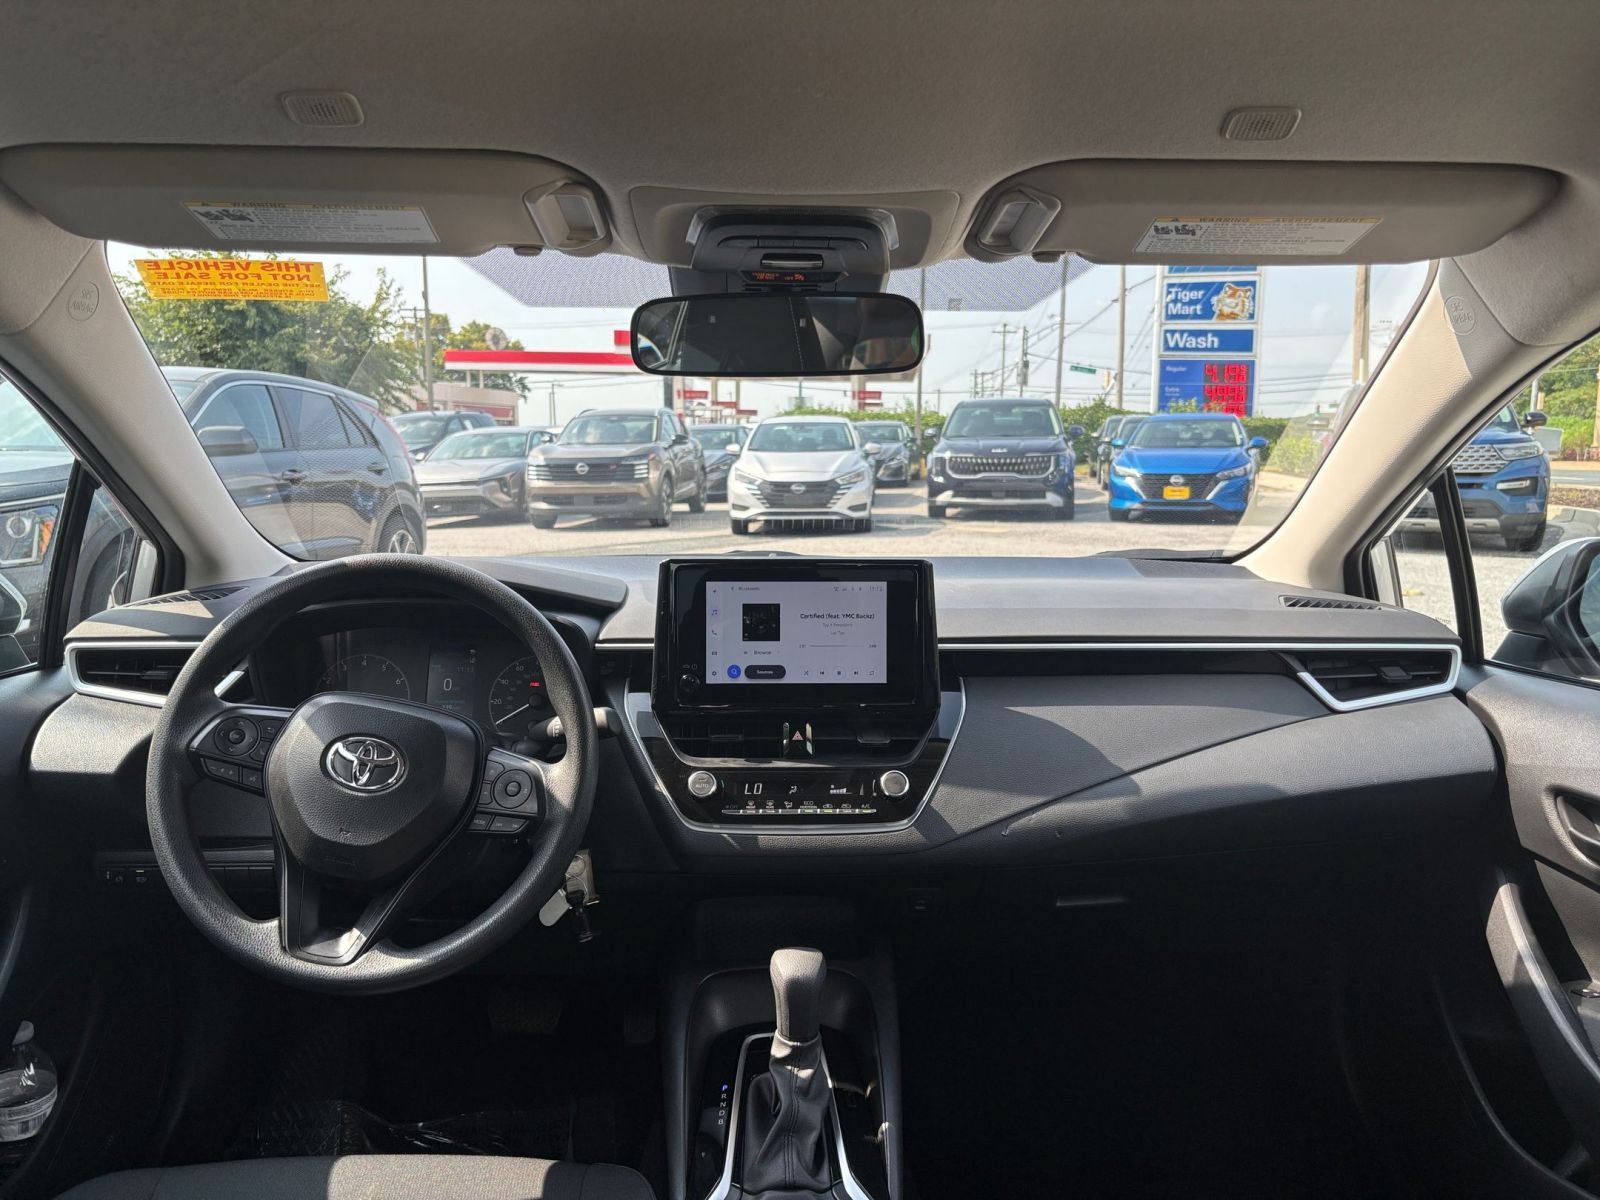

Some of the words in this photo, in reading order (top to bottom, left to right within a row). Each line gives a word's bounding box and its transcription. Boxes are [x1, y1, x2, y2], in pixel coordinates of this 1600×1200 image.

[1168, 287, 1205, 302] Tiger
[1167, 303, 1202, 315] Mart
[1166, 332, 1219, 348] Wash
[443, 678, 453, 691] 0
